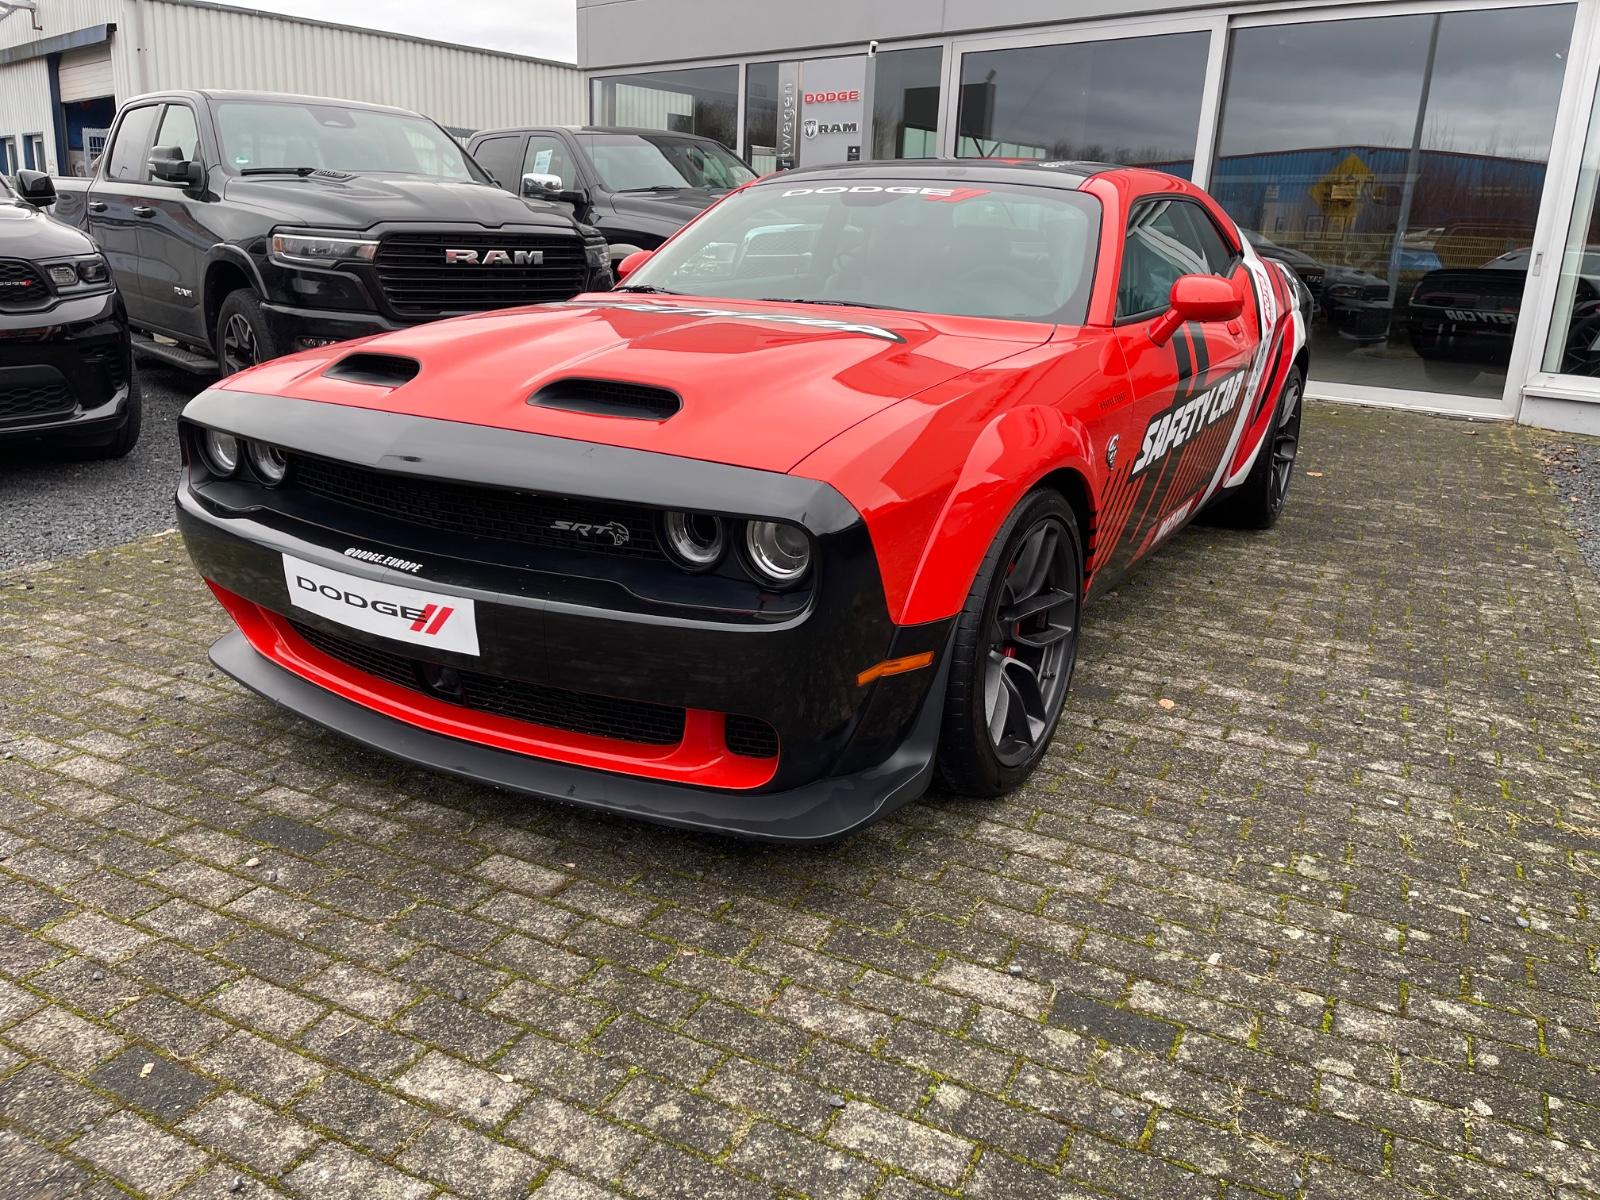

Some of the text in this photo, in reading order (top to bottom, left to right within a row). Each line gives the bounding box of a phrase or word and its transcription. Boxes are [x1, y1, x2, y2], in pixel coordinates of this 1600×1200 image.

[804, 91, 860, 104] DODGE
[819, 122, 858, 133] RAM
[782, 186, 955, 198] DODGE
[445, 248, 544, 265] RAM
[1132, 370, 1245, 475] SAFETY CAR
[550, 520, 613, 536] SRT
[344, 547, 423, 573] @DODGE.EUROPE
[296, 575, 428, 623] DODGE
